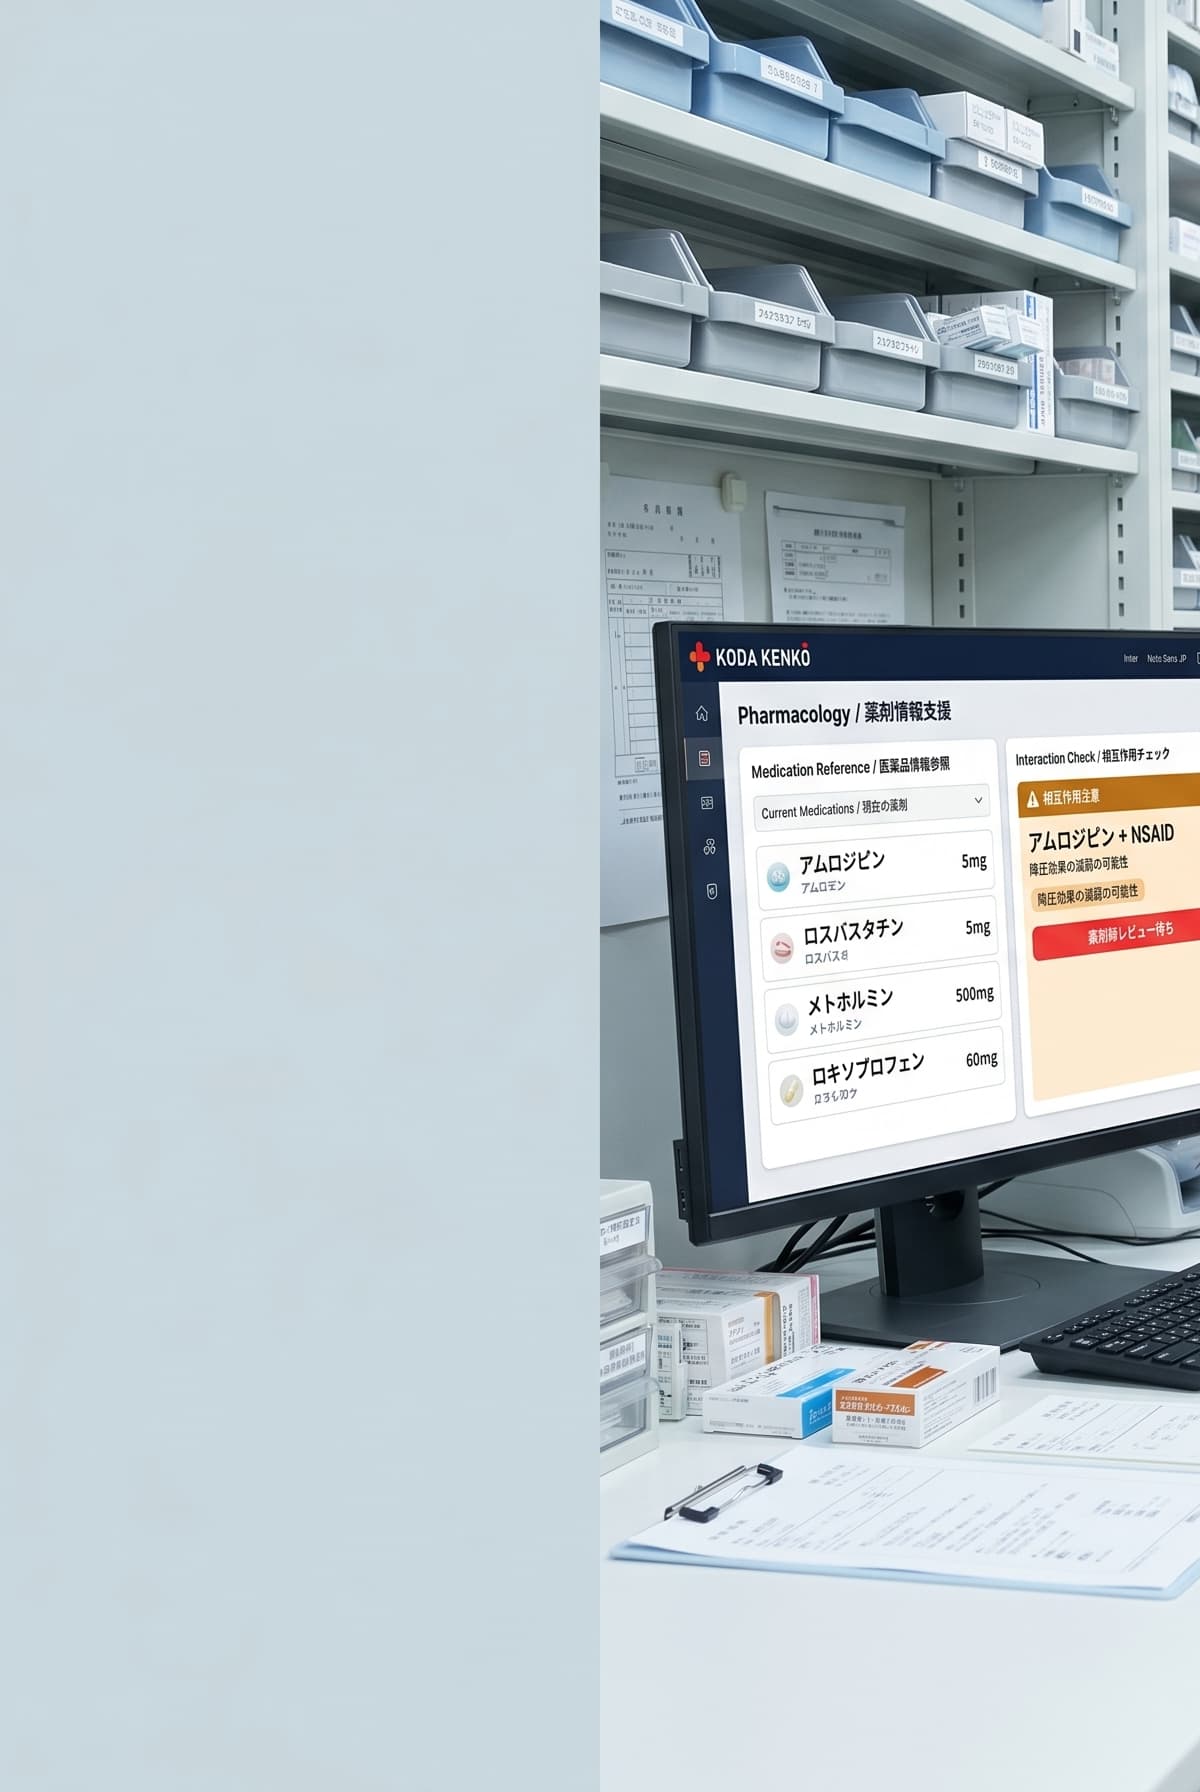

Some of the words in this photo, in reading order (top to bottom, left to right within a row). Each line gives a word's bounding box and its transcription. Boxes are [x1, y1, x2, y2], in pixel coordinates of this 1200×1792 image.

[715, 648, 758, 667] KODA
[1123, 653, 1139, 663] Inter
[1162, 653, 1178, 663] Sans
[1179, 653, 1187, 663] JP
[738, 703, 851, 727] Pharmacology
[864, 700, 951, 723] 薬剤情報支援
[1016, 753, 1066, 767] Interaction
[1067, 751, 1096, 764] Check
[1102, 746, 1170, 763] 相互作用チェック
[752, 762, 814, 779] Medication
[816, 761, 870, 776] Reference
[761, 806, 797, 820] Current
[799, 802, 855, 817] Medications
[1029, 826, 1115, 853] アムロジピン
[1131, 824, 1175, 844] NSAID
[799, 849, 885, 875] アムロジピン
[961, 853, 987, 871] 5mg
[804, 917, 904, 945] ロスバスタチン
[965, 920, 991, 937] 5mg
[808, 988, 894, 1016] メトホルミン
[955, 986, 995, 1003] 500mg
[810, 1019, 863, 1036] メトホルミン
[965, 1052, 998, 1068] 60mg
